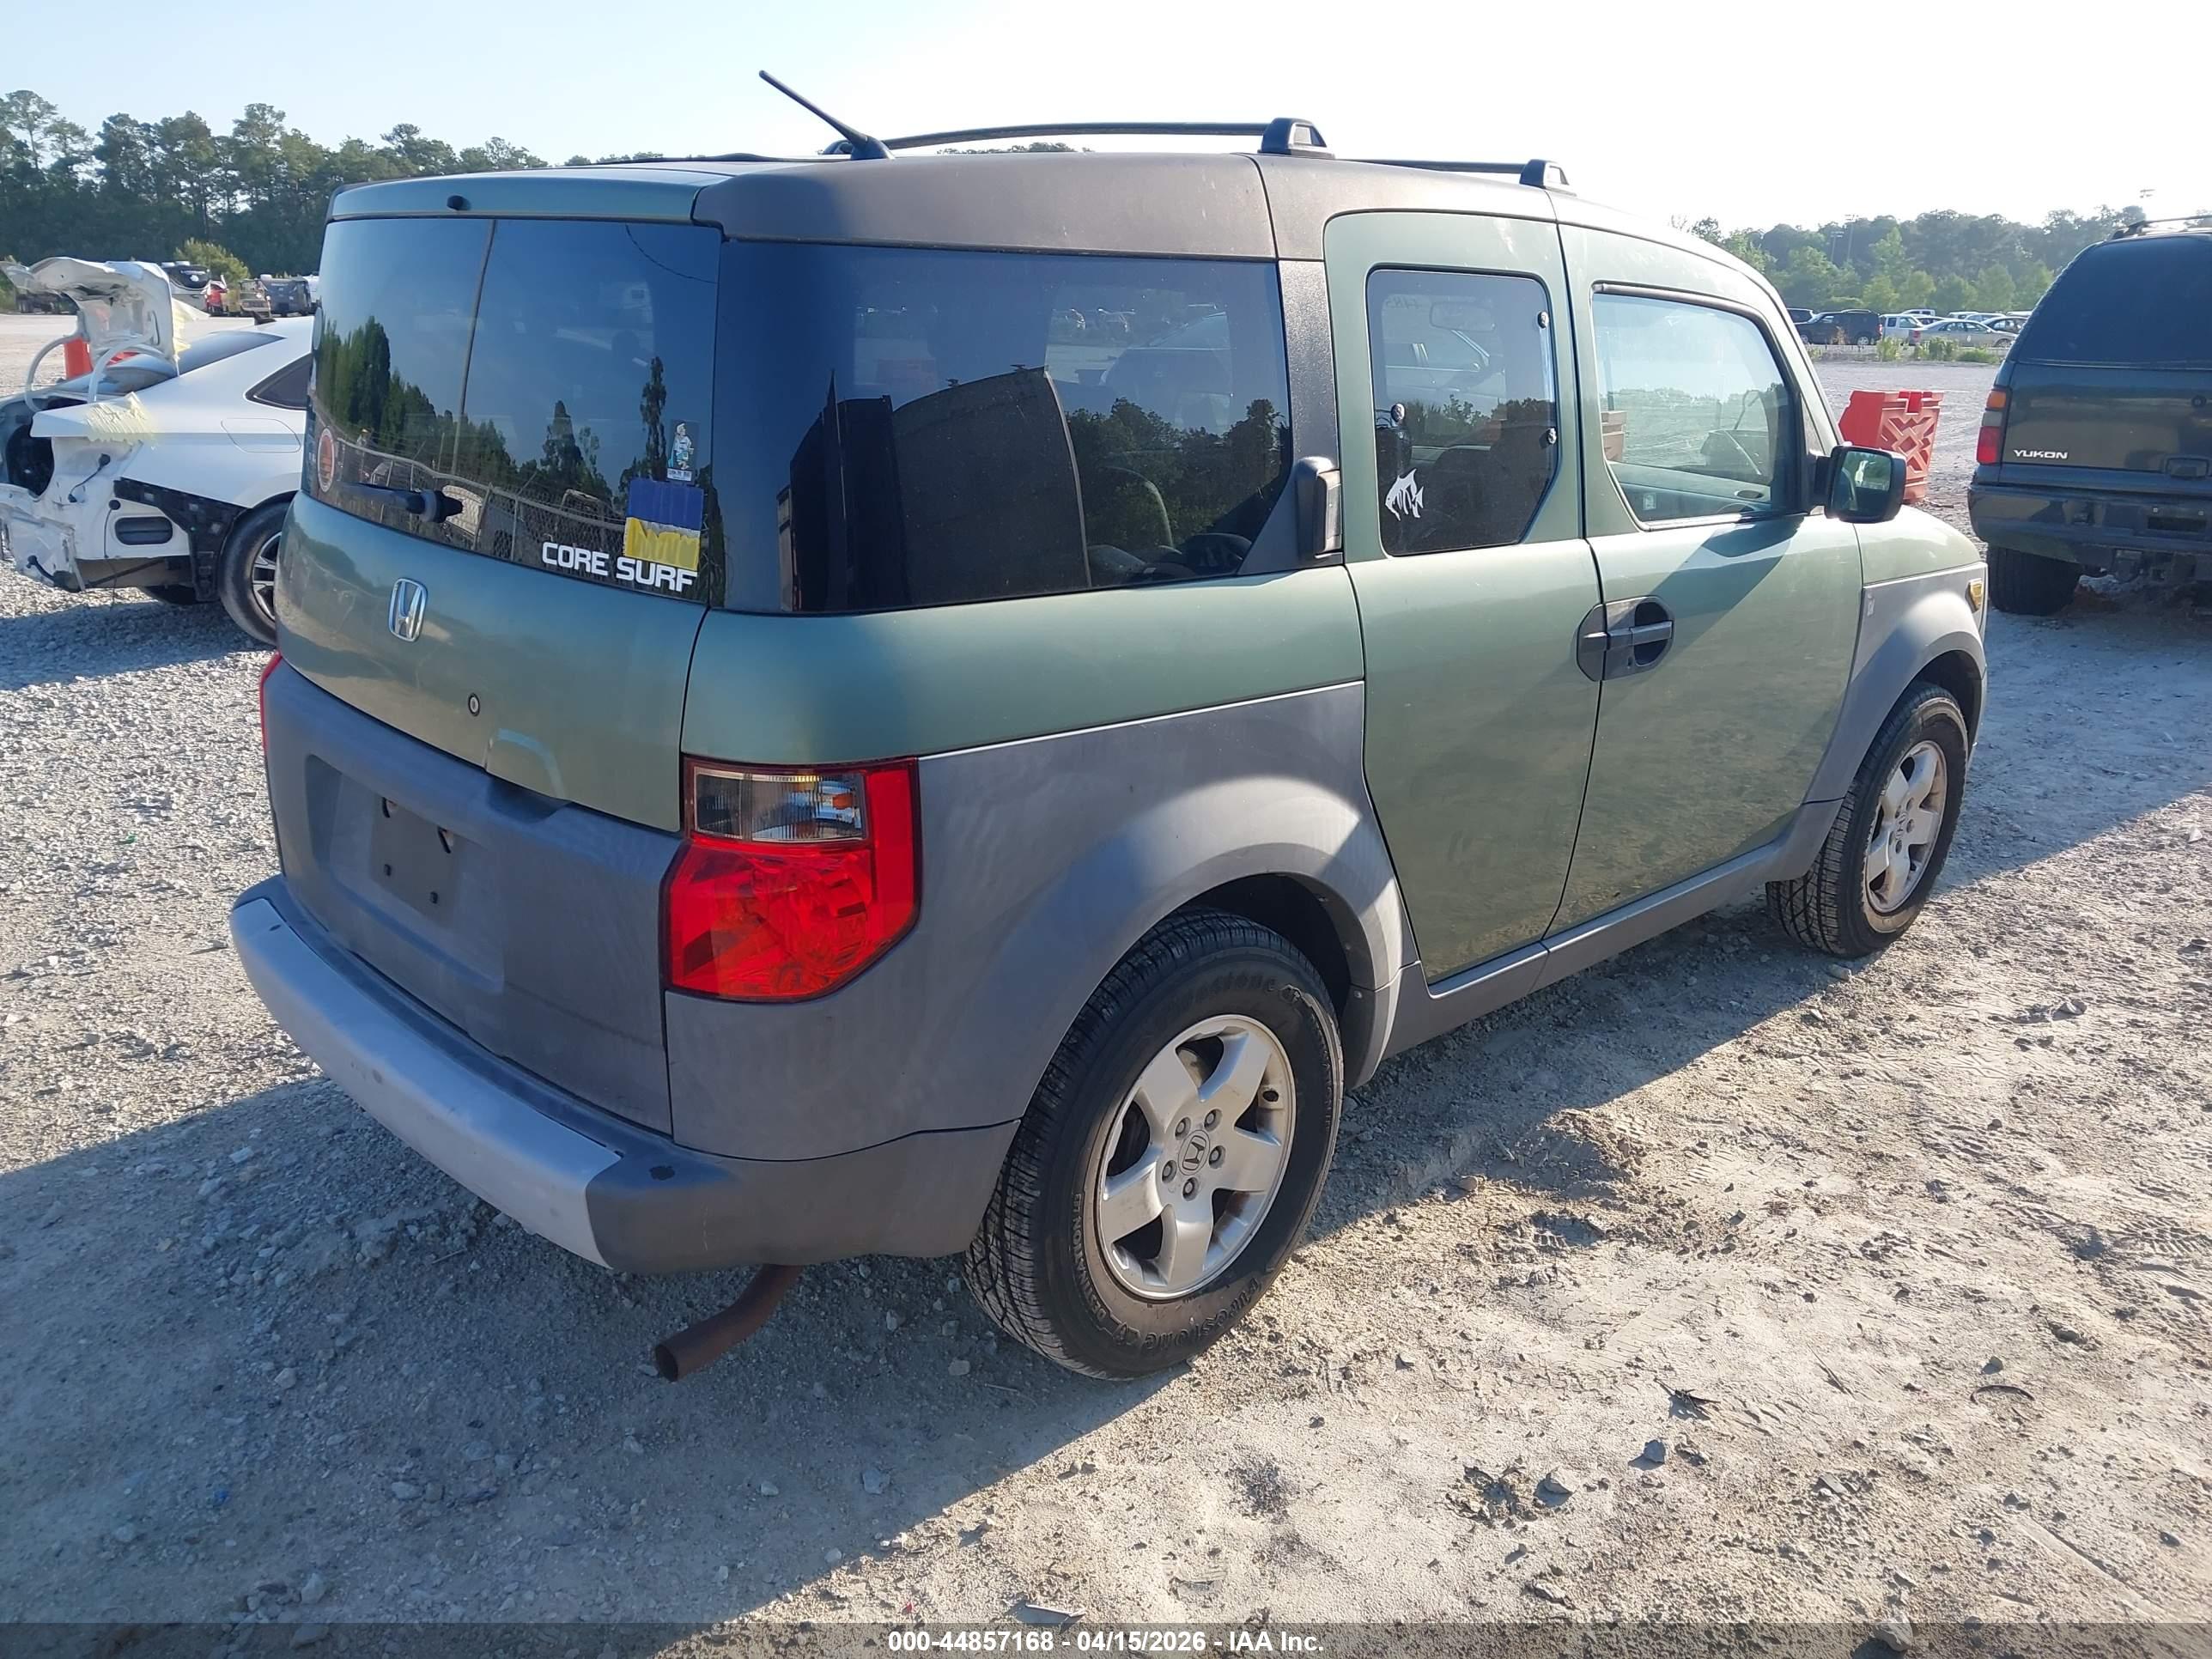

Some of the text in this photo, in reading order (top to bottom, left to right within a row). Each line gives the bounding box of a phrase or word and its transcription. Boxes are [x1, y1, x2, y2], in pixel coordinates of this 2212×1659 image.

[2013, 449, 2069, 459] YUKON
[542, 541, 698, 592] CORE SURF
